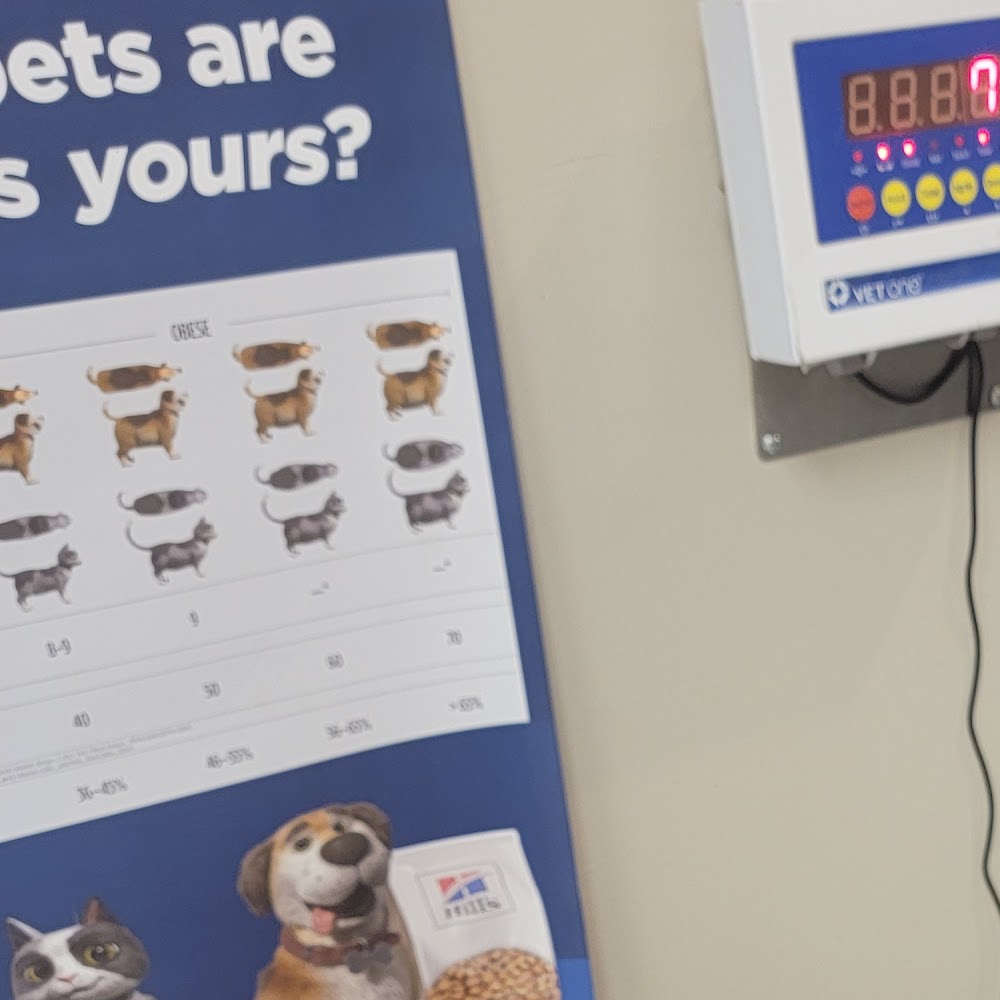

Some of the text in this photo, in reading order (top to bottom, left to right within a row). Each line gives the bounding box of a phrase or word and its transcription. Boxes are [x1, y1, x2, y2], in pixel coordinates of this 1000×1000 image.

[0, 15, 336, 103] ets are
[67, 104, 372, 225] yours?
[169, 319, 212, 341] OBESE
[73, 711, 91, 728] 40
